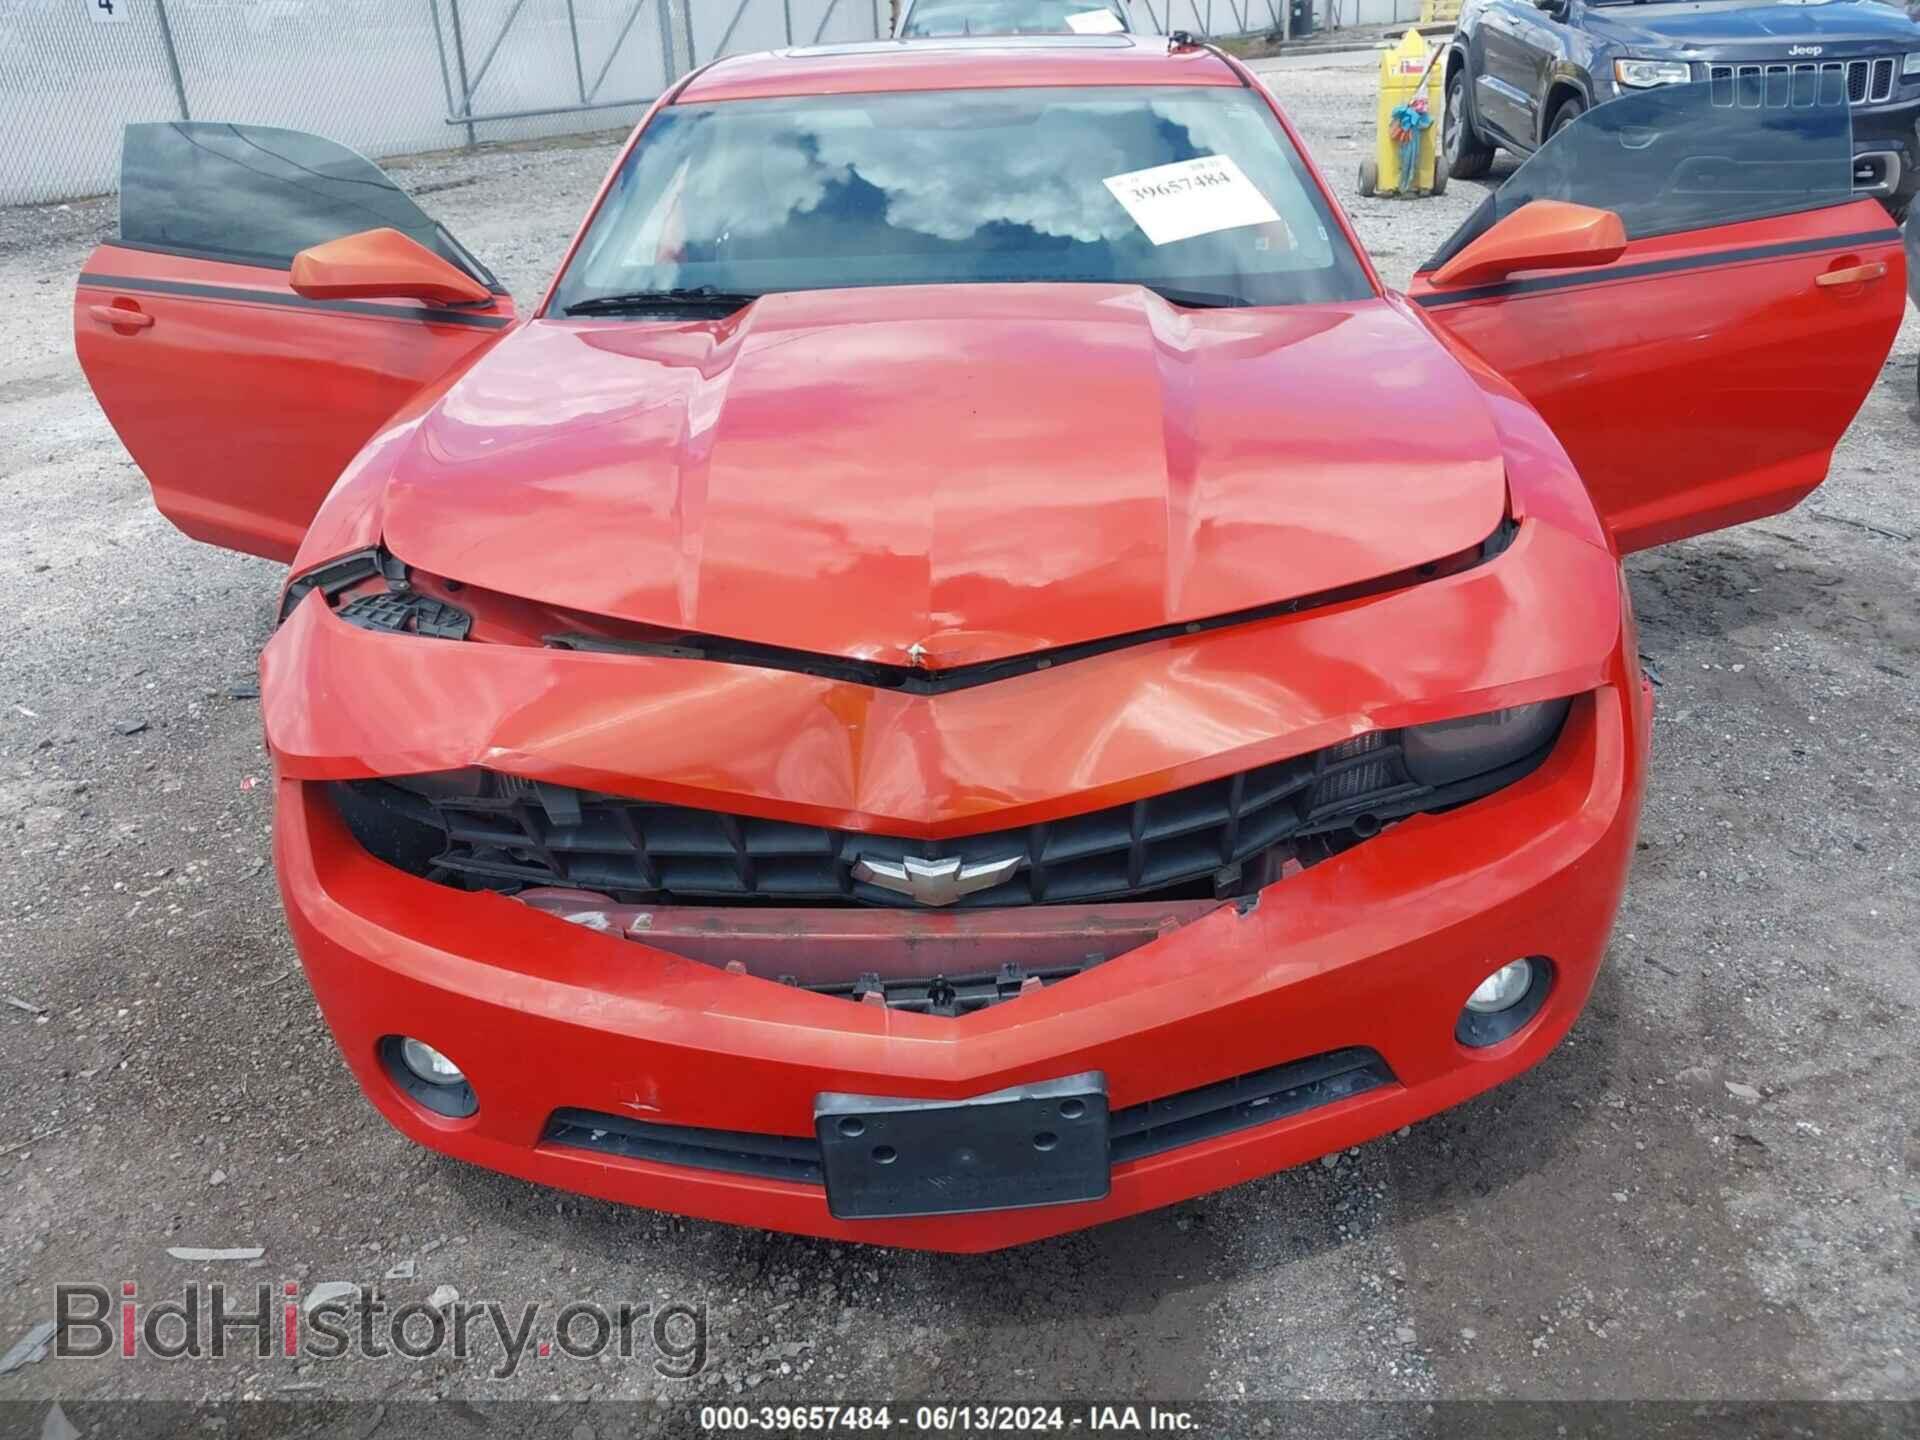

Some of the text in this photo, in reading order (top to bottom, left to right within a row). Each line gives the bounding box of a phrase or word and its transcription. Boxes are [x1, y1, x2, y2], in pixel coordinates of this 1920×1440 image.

[98, 0, 113, 15] 4
[1788, 44, 1823, 56] Jeep
[1131, 171, 1231, 203] 39657484
